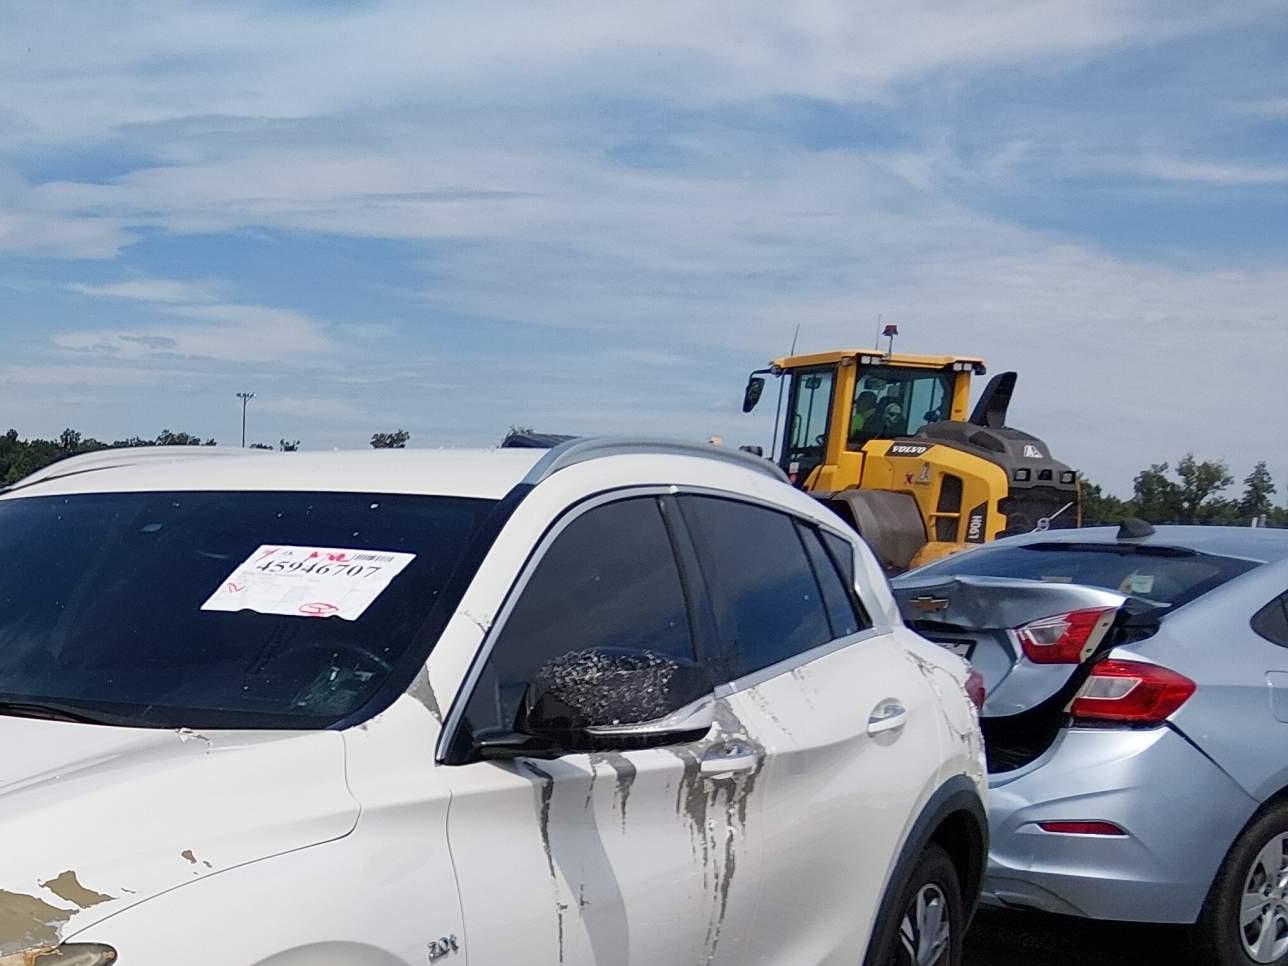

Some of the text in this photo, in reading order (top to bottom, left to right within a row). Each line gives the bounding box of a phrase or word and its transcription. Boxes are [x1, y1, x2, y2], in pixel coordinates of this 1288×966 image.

[892, 445, 927, 454] VOLVO
[967, 515, 983, 539] L90H
[256, 560, 381, 578] 45946707
